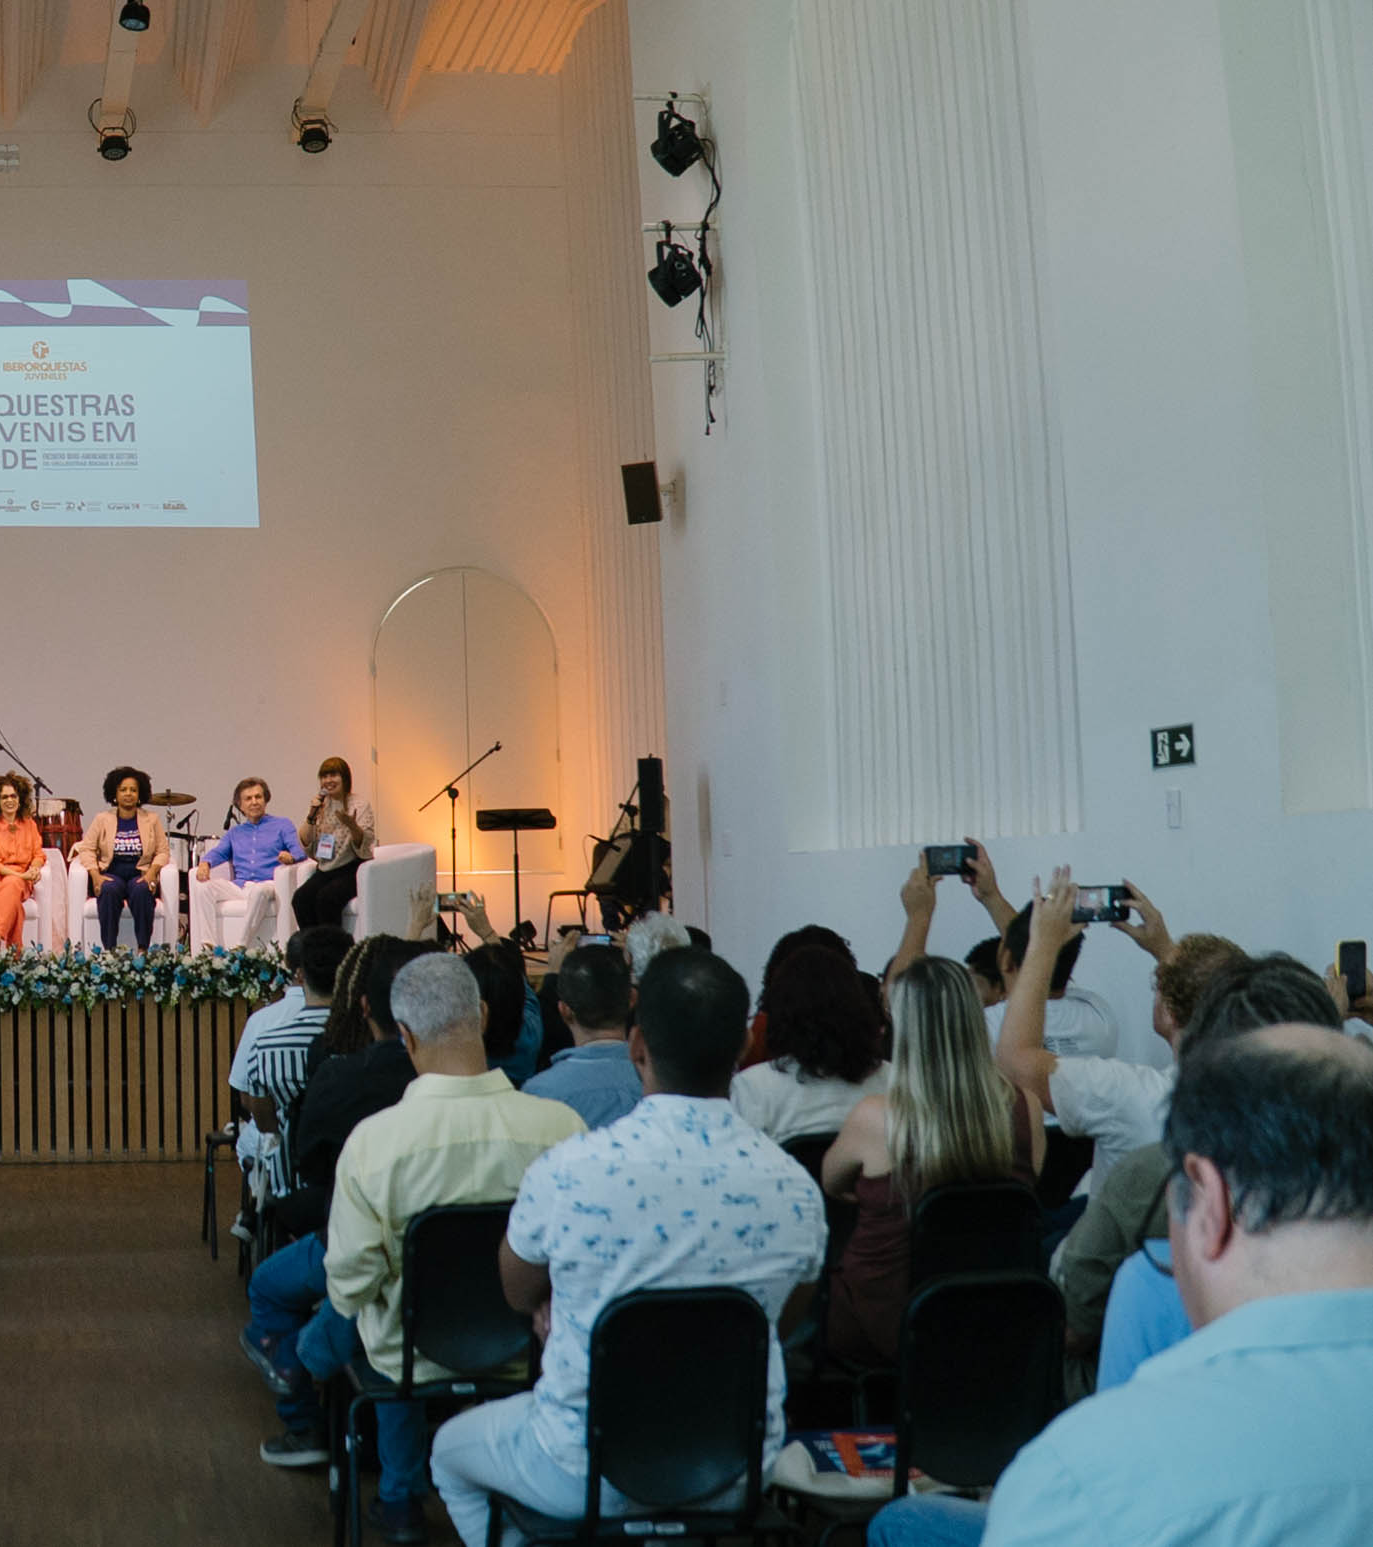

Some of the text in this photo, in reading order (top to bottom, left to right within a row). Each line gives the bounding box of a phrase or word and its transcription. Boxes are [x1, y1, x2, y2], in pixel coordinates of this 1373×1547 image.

[2, 362, 87, 372] IBERORQUESTAS
[24, 372, 67, 381] JUVENILES
[93, 421, 136, 443] EM
[113, 843, 142, 851] USTIC
